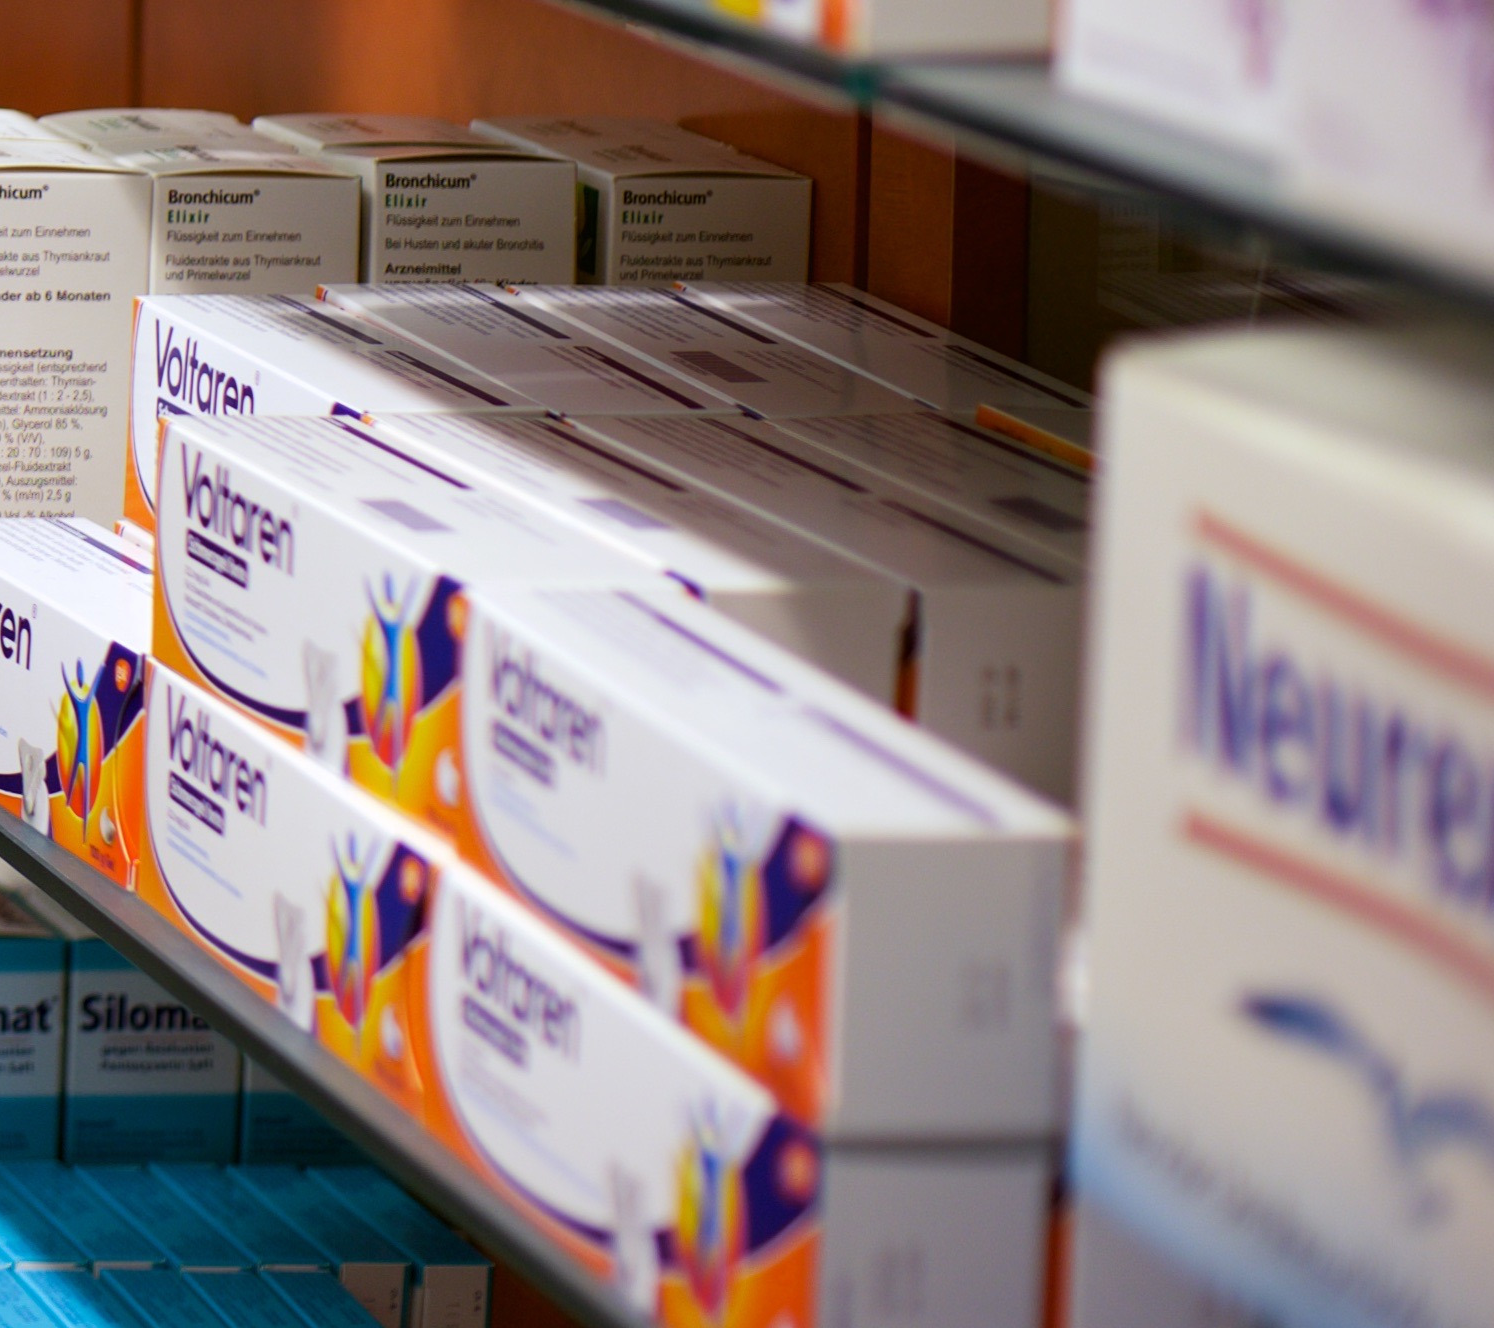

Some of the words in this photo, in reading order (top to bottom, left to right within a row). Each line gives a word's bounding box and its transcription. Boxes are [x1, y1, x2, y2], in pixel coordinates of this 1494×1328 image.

[385, 194, 427, 207] Elixir
[168, 210, 209, 223] Elixir
[465, 215, 520, 226] Einnehmen
[622, 211, 664, 224] Elixir
[11, 228, 32, 237] zum
[35, 226, 90, 237] Einnehmen
[167, 231, 218, 244] Flüssigkeit
[222, 232, 242, 241] zum
[246, 231, 301, 242] Einnehmen
[22, 253, 40, 262] aus
[44, 250, 110, 264] Thymiankraut
[166, 255, 229, 266] Fluidextrakte
[233, 257, 250, 266] aus
[254, 255, 320, 268] Thymiankraut
[166, 270, 183, 280] und
[187, 270, 250, 280] Primelwurzel
[385, 263, 461, 275] Arzneimittel
[26, 291, 41, 301] ab
[45, 291, 52, 301] 6
[57, 291, 111, 301] Monaten
[1181, 562, 1494, 923] Neure
